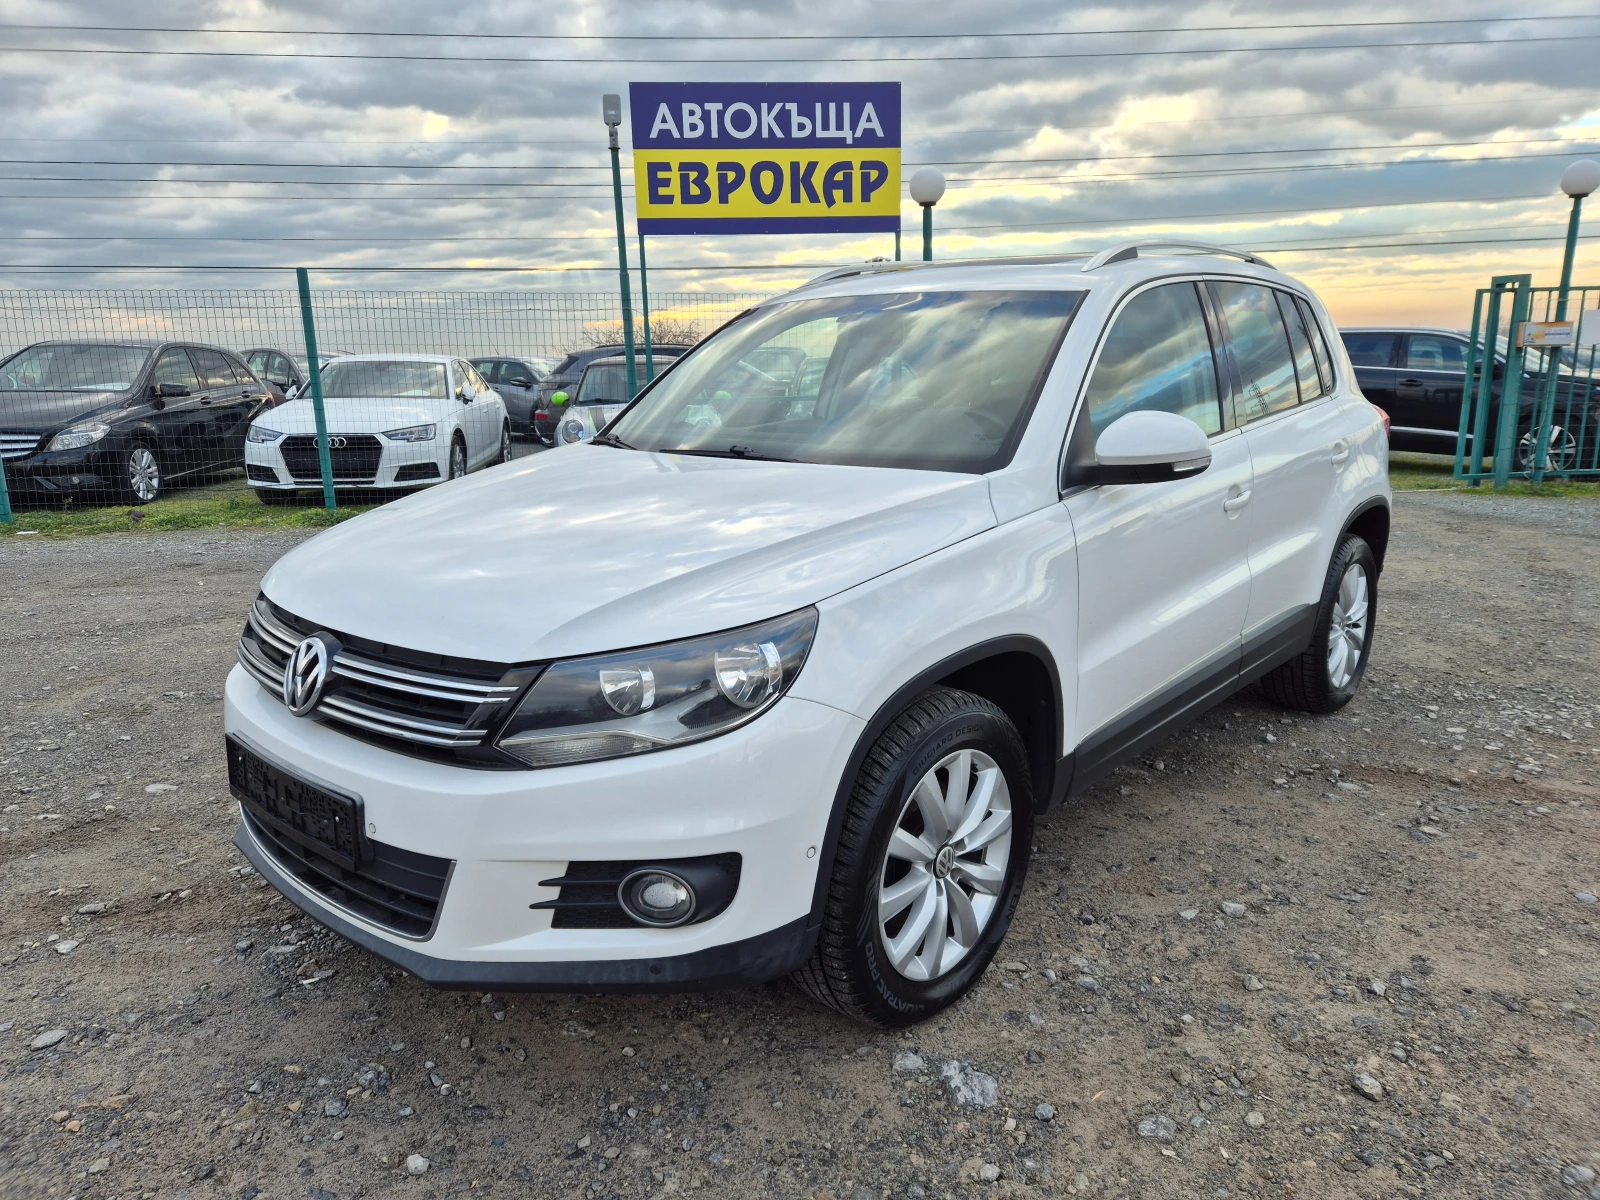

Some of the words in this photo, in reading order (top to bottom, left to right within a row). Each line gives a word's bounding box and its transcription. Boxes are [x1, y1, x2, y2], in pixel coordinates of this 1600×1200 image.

[649, 102, 885, 144] АВТОКЪЩА
[648, 160, 889, 208] ЕВРОКАР
[913, 733, 953, 775] GIUGIARO
[956, 724, 984, 737] DESIGN
[865, 941, 880, 981] PRO
